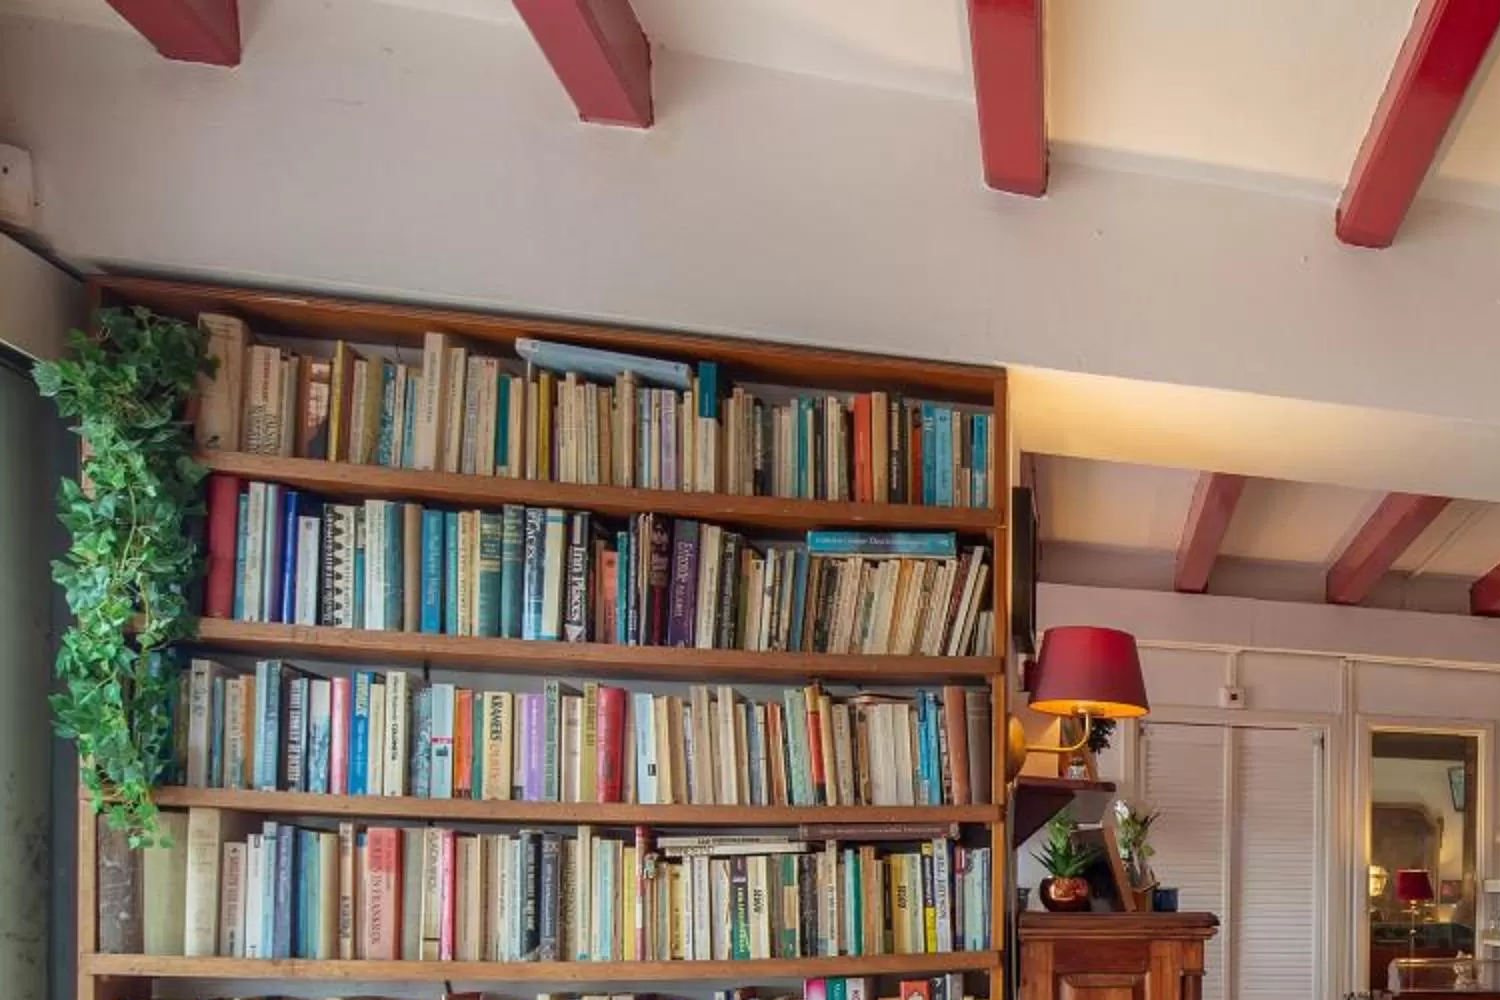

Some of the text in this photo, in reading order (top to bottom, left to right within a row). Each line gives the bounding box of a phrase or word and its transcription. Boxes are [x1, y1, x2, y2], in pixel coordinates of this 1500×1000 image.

[569, 544, 586, 622] Inn Places
[488, 694, 504, 742] KRAMERS
